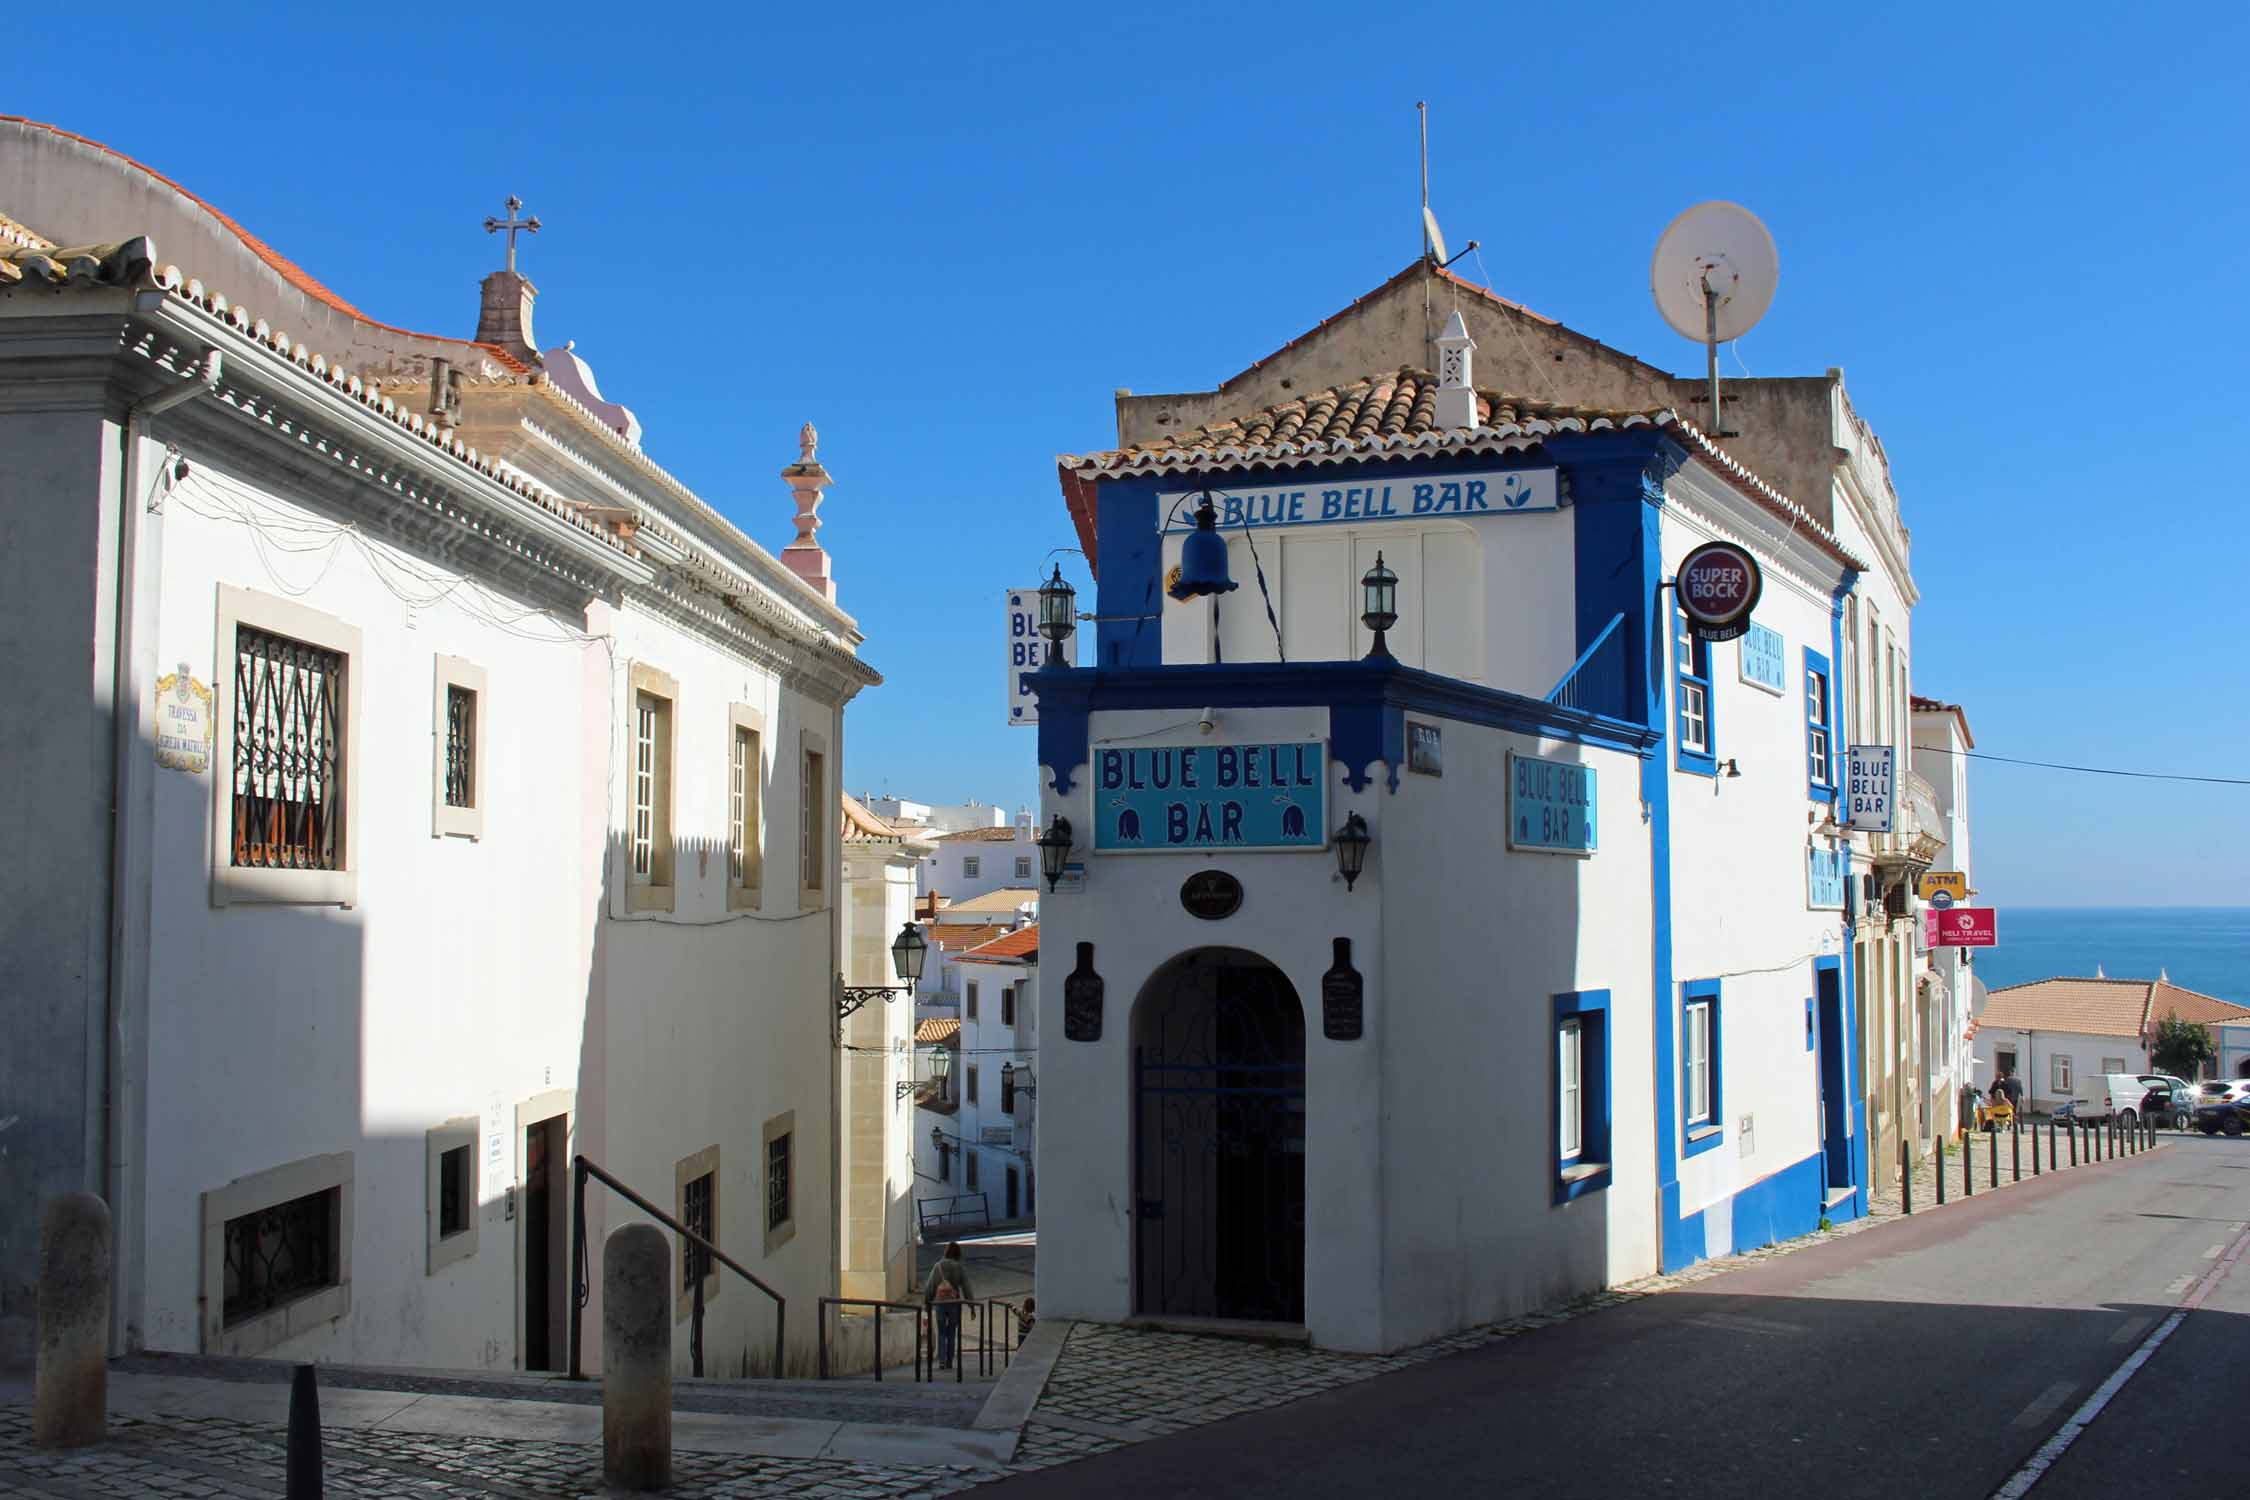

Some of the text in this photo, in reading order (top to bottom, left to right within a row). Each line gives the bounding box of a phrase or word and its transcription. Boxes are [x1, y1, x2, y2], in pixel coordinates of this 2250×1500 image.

[1223, 480, 1488, 524] BLUE BELL BAR
[1689, 567, 1742, 583] SUPER
[1692, 583, 1739, 598] BOCK
[1698, 626, 1739, 641] BLUE BELL
[168, 704, 197, 721] TRAVESSA
[1101, 744, 1313, 790] BLUE BELL
[1852, 761, 1888, 776] BLUE
[1519, 759, 1591, 807] BLUE BELL
[1851, 779, 1887, 795] BELL
[1855, 798, 1883, 813] BAR
[1167, 800, 1244, 843] BAR
[1543, 805, 1569, 842] BAR
[1926, 875, 1958, 885] ATM
[1961, 929, 1993, 937] TRAVEL
